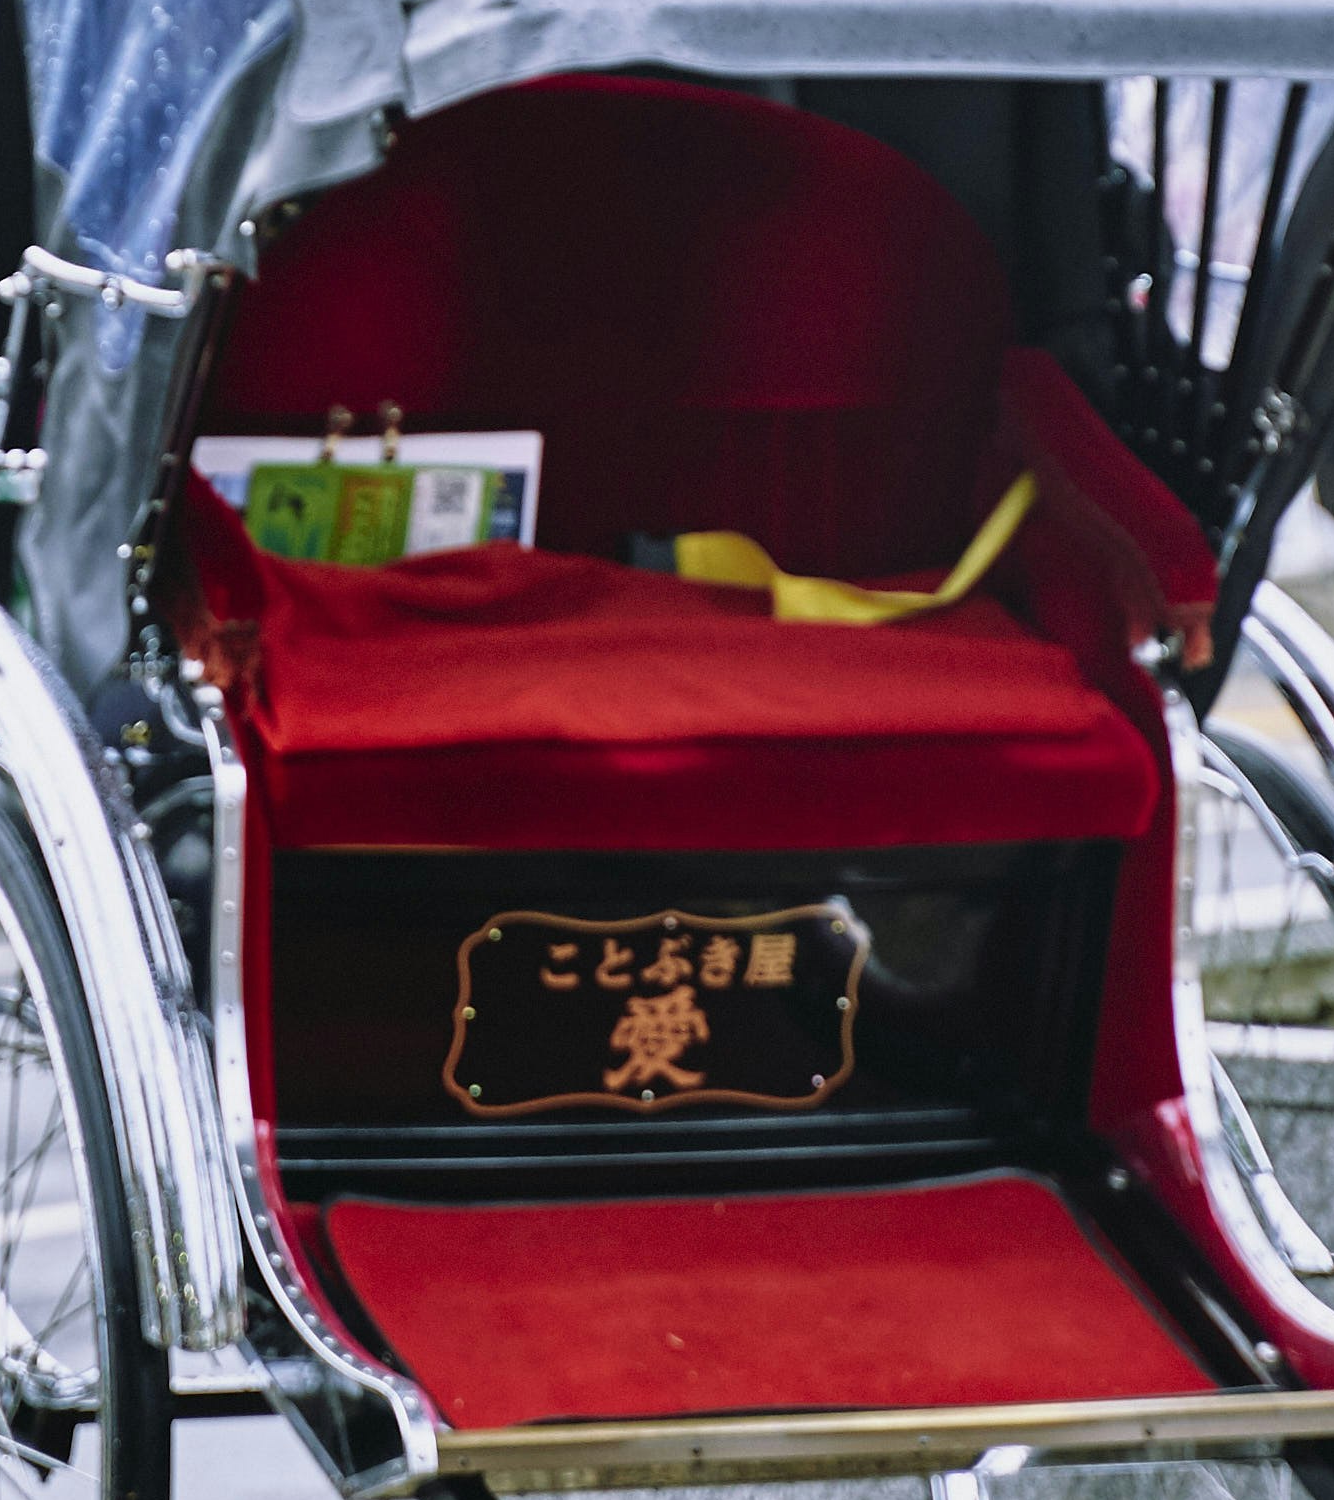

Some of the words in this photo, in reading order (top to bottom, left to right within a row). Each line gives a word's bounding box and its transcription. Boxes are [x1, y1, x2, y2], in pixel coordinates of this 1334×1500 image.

[540, 933, 796, 990] ことぶき屋
